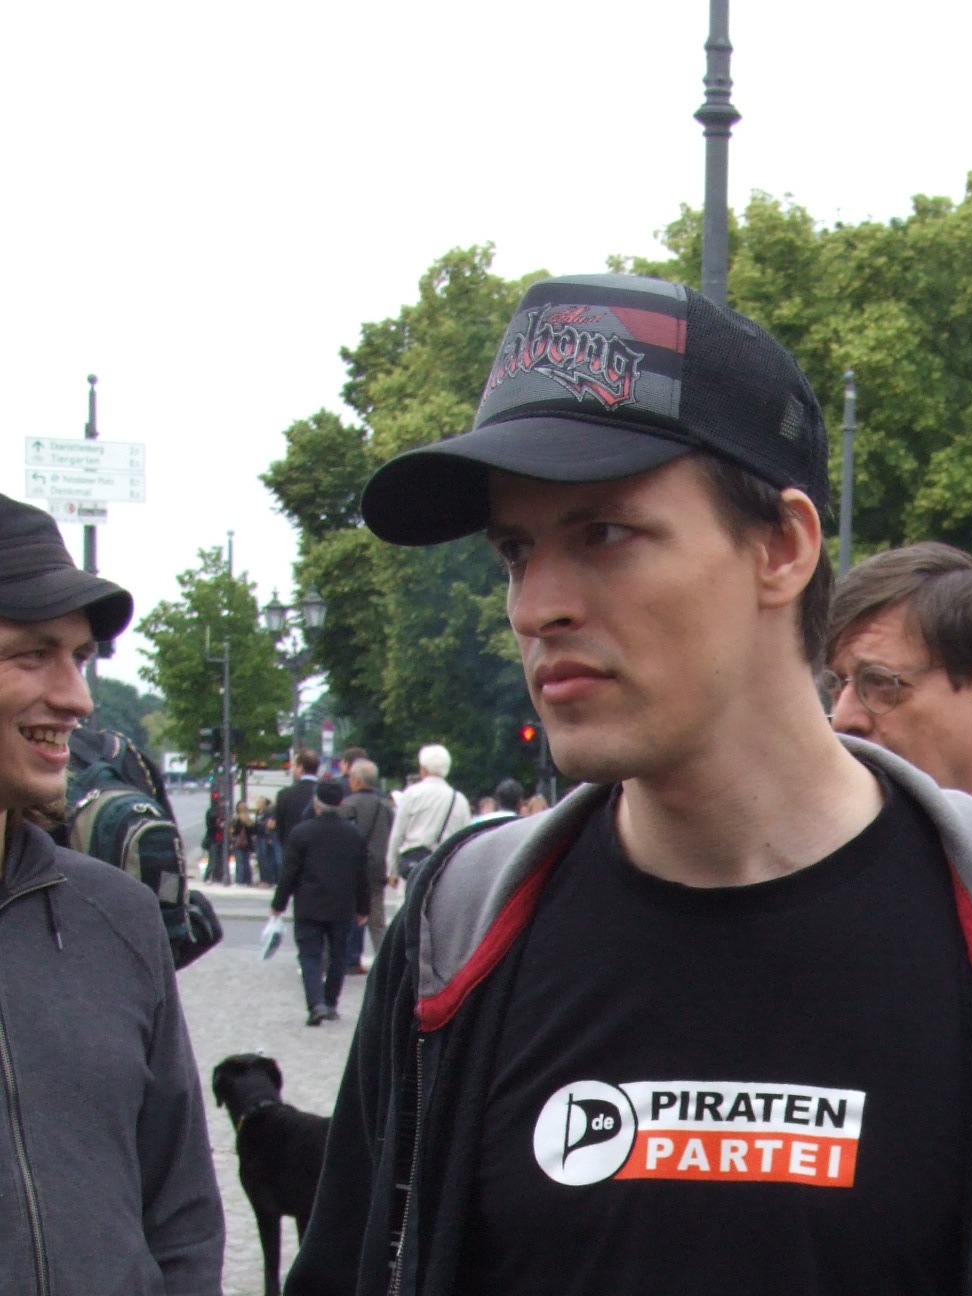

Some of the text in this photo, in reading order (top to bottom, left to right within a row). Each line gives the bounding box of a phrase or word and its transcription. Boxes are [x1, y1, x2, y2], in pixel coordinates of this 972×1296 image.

[51, 454, 101, 466] Tiergarten
[591, 1114, 614, 1131] de
[651, 1091, 848, 1129] PIRATEN
[645, 1137, 842, 1178] PARTEI
